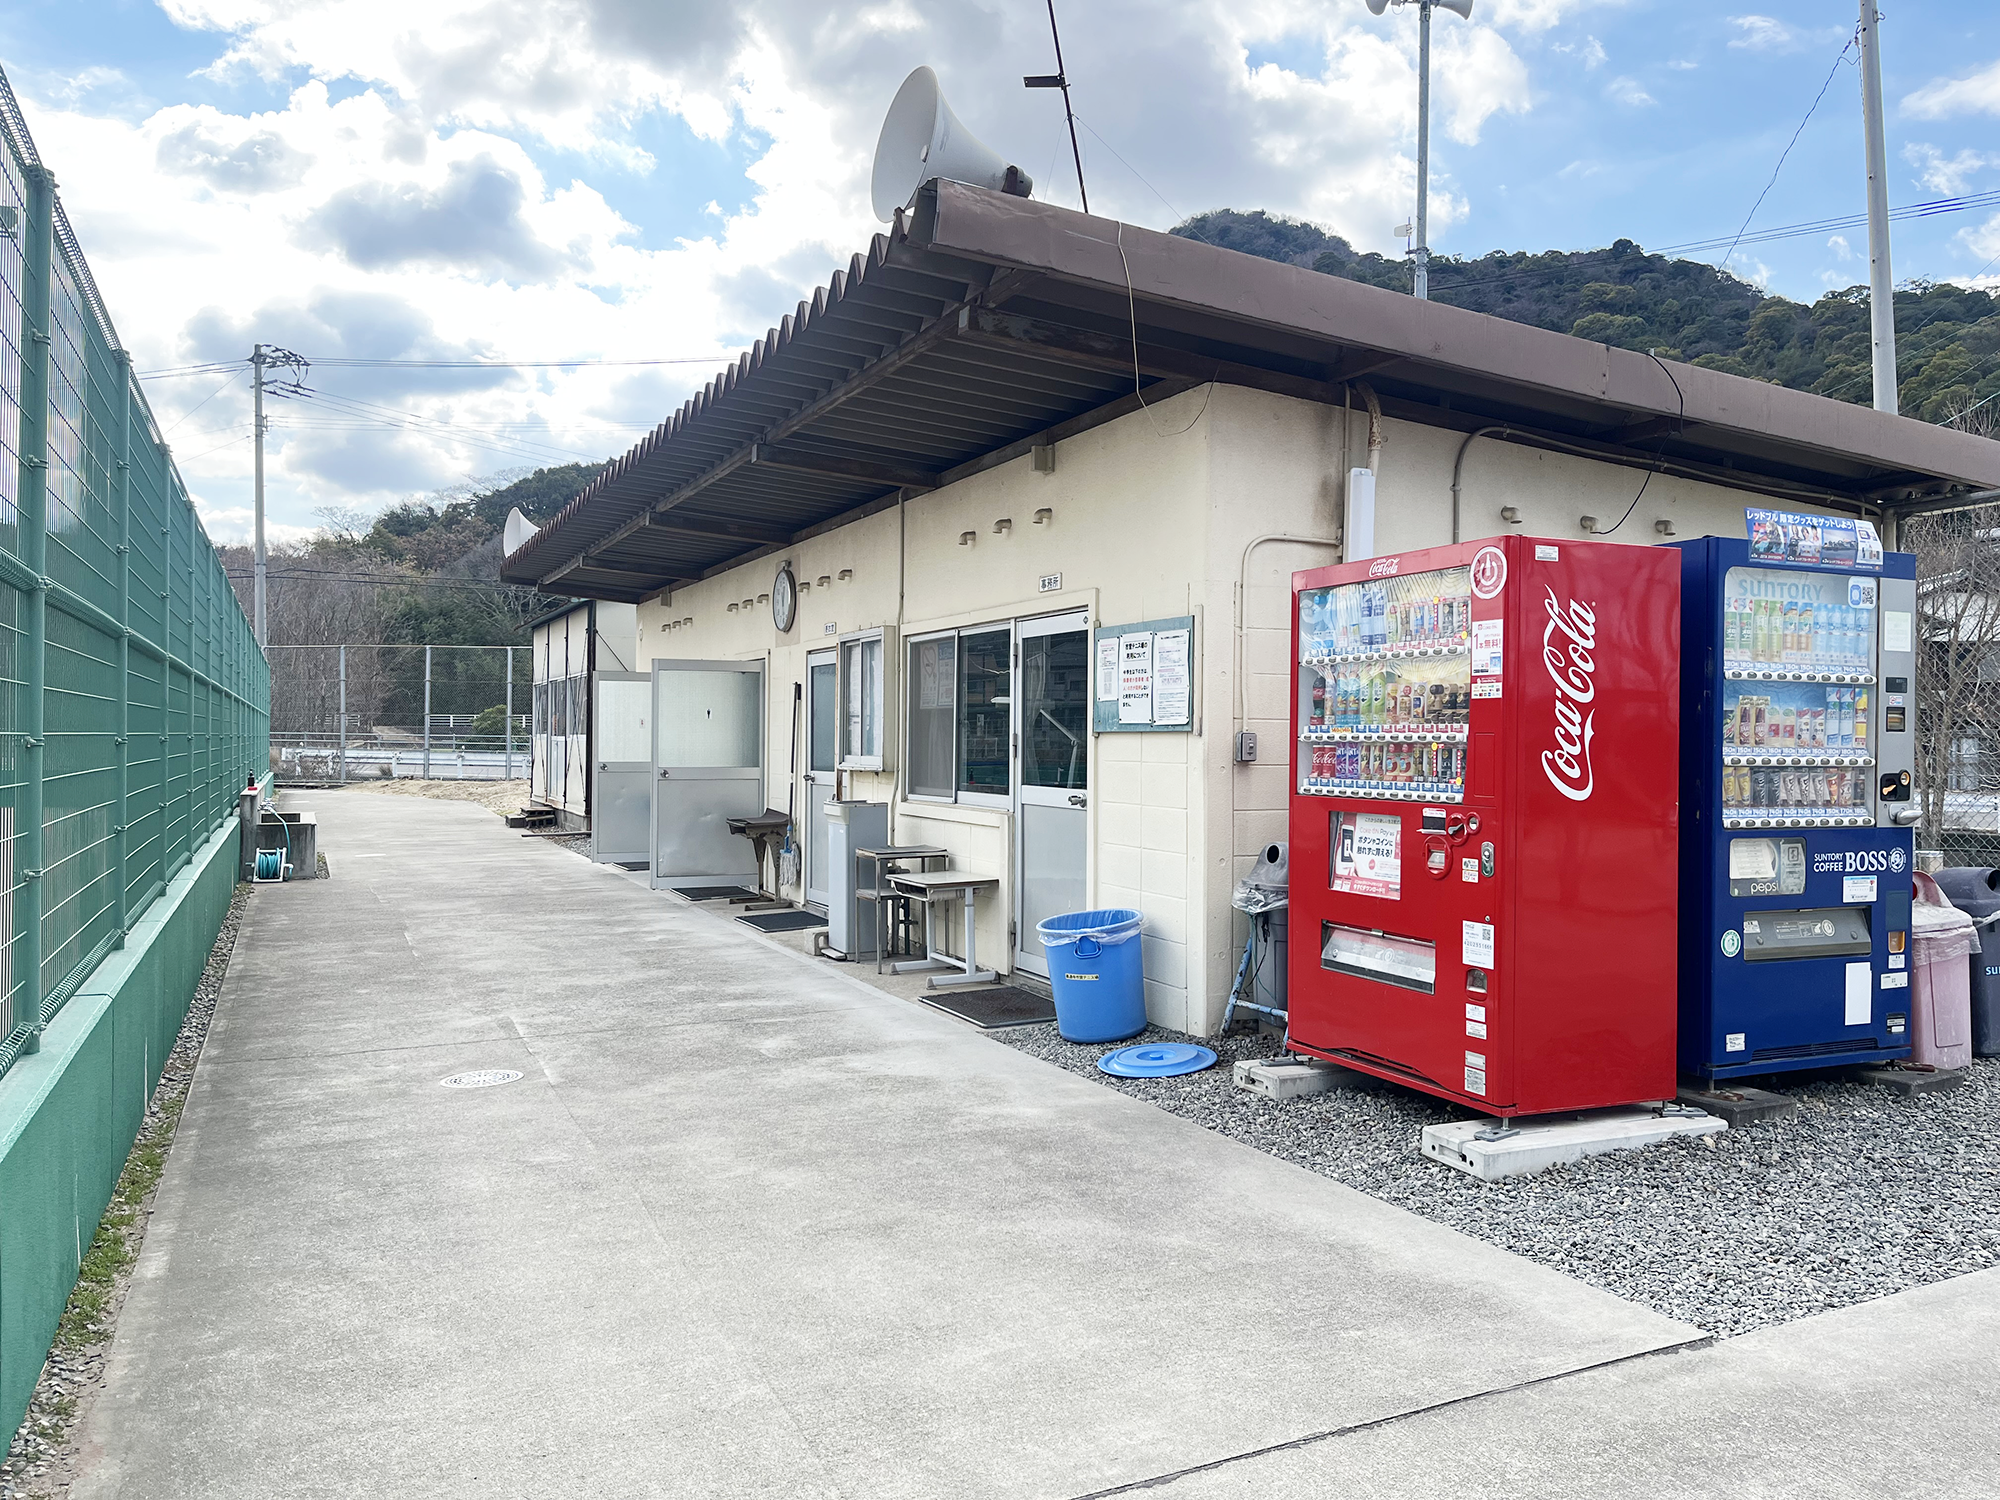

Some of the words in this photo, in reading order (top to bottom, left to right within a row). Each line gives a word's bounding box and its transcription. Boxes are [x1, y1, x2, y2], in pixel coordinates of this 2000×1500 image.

[1746, 510, 1778, 522] レッドブル
[1368, 558, 1400, 578] Coca-Cola
[1738, 578, 1824, 601] SUNTORY
[1541, 584, 1596, 801] Coca-Cola
[1358, 836, 1393, 846] ボタンやコインに
[1357, 846, 1393, 858] 触れずに買える!
[1814, 853, 1843, 861] SUNTORY
[1814, 862, 1843, 872] COFFEE
[1845, 851, 1887, 872] BOSS
[1751, 880, 1779, 894] pepsi
